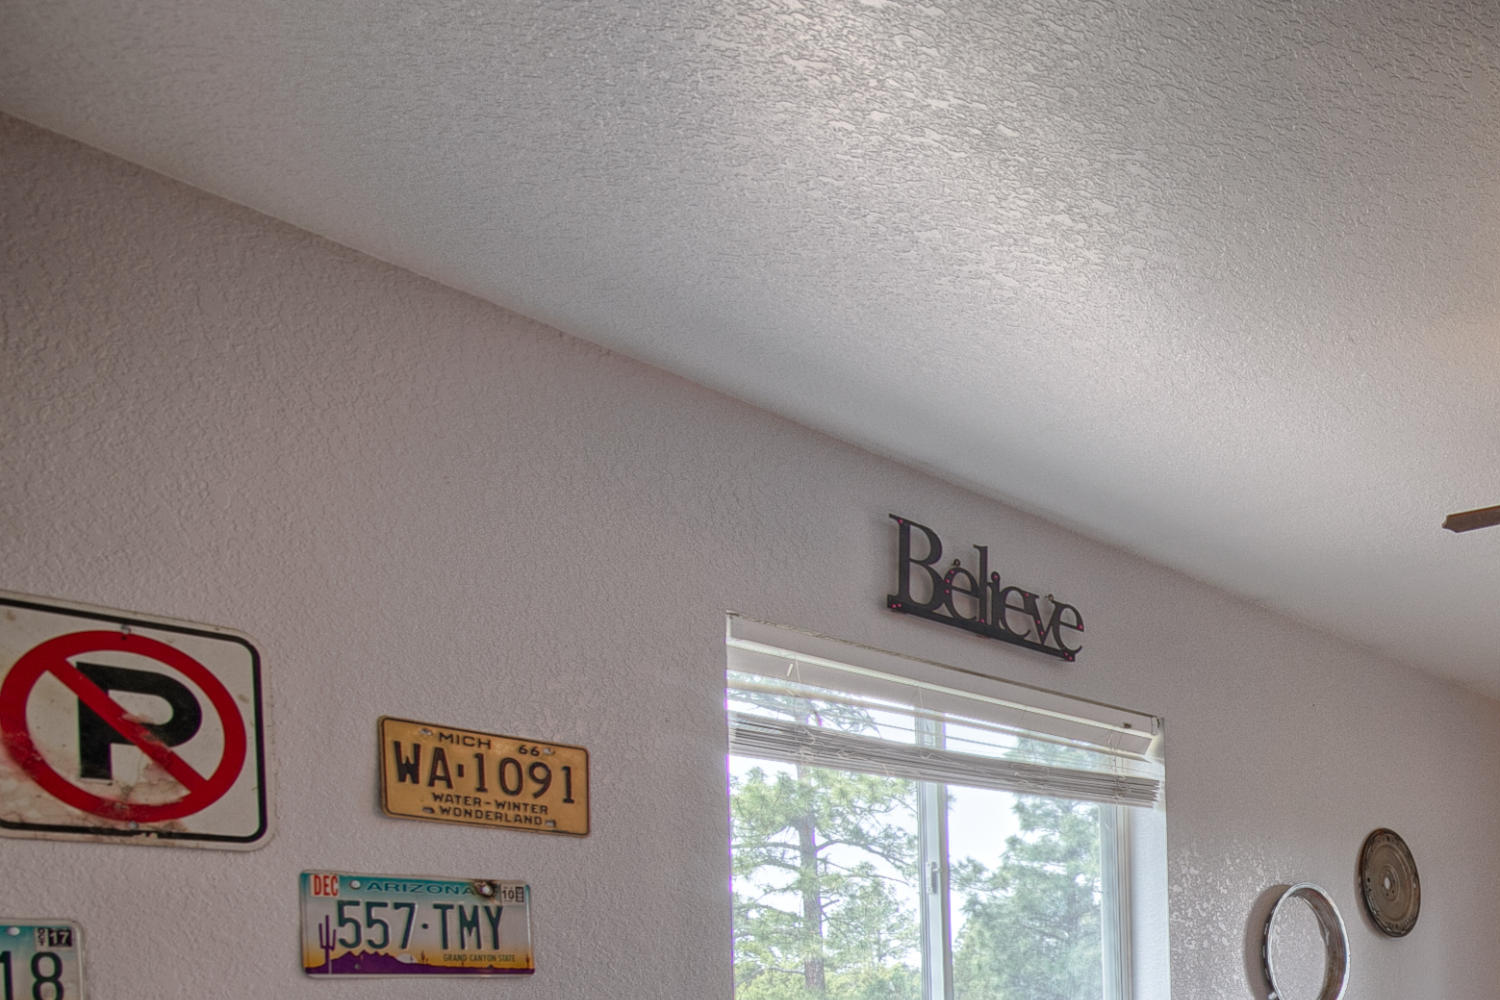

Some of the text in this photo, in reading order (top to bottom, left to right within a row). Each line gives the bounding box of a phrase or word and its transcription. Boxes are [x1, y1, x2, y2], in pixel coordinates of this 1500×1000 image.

[887, 513, 1084, 655] Believe
[76, 662, 202, 780] P
[437, 732, 540, 757] MICH 66
[439, 806, 543, 826] WONDERLAND
[313, 875, 338, 896] DEC
[367, 882, 478, 895] ARIZONA
[49, 931, 70, 946] 17
